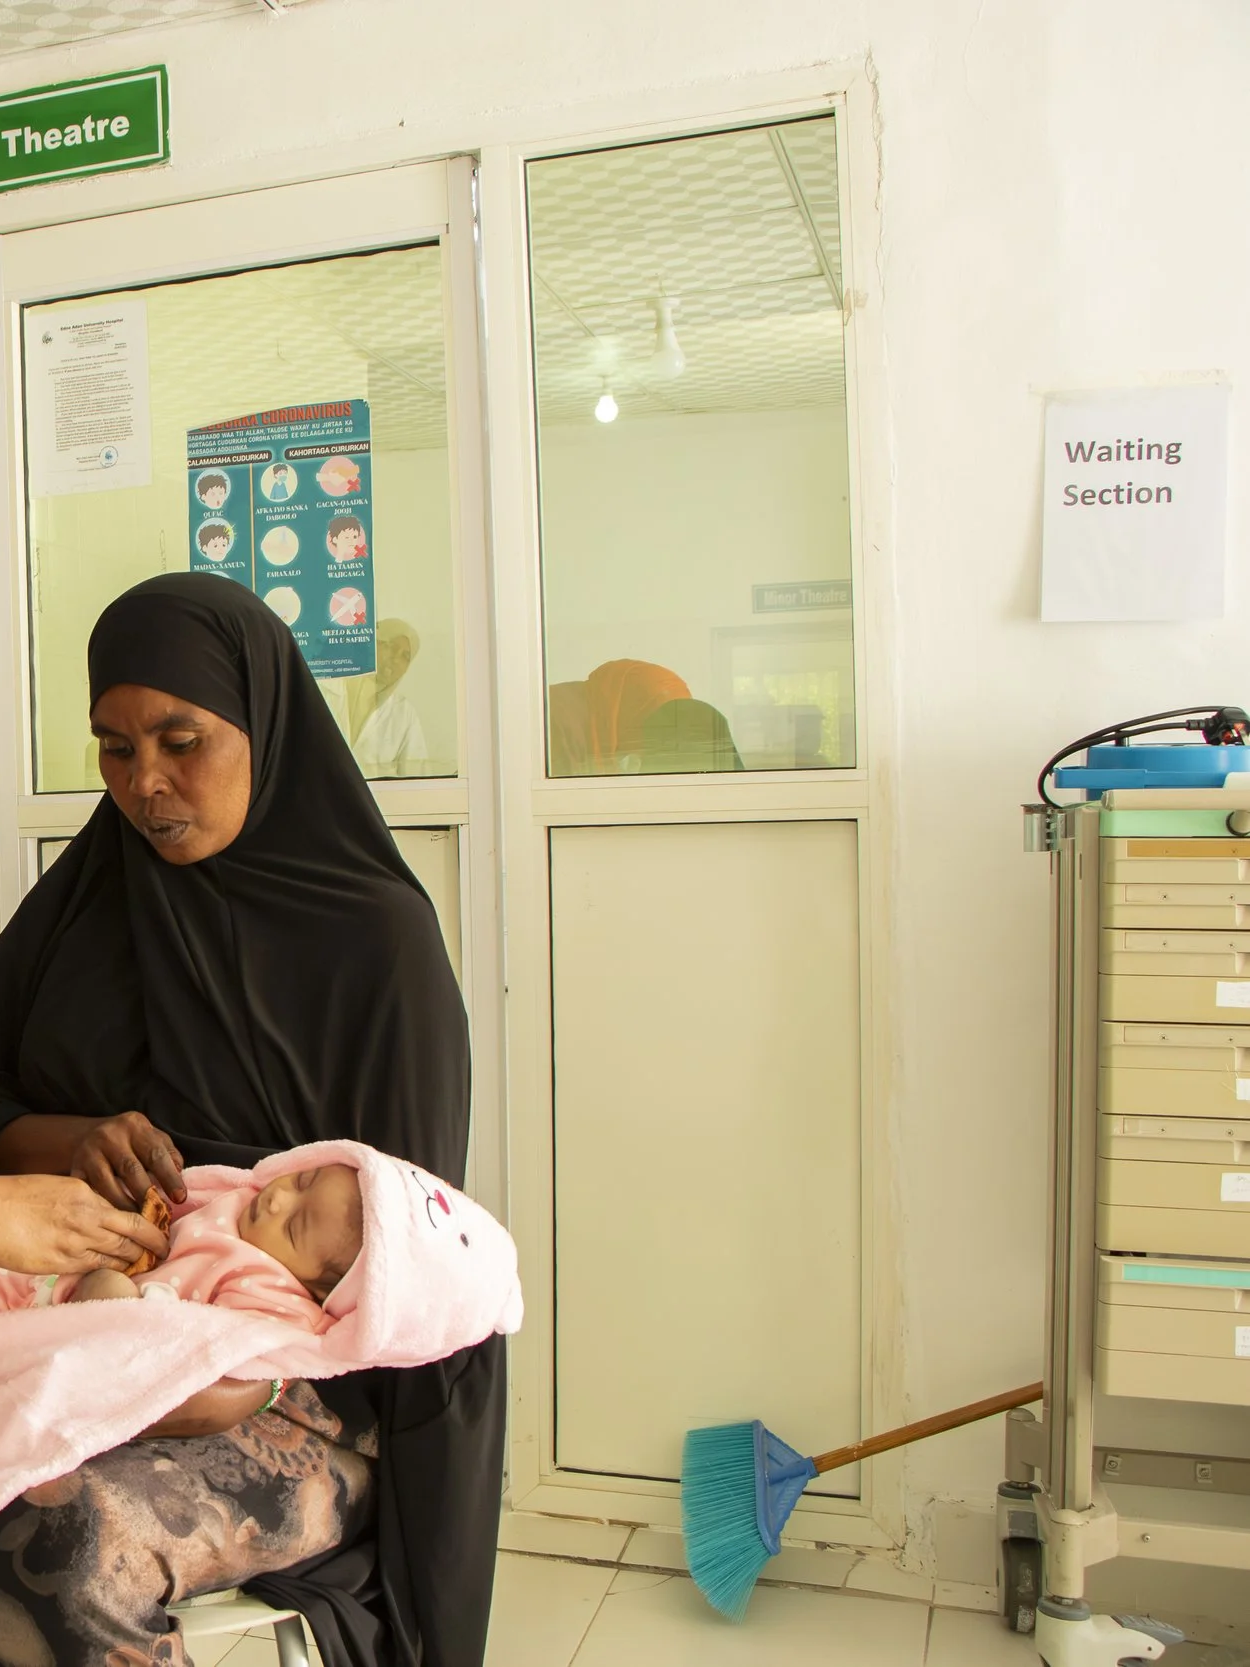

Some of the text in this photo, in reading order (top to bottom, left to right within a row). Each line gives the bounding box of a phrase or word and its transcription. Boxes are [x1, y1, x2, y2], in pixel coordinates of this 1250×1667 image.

[1, 115, 130, 158] Theatre
[261, 401, 352, 425] CORONAVIRUS
[289, 447, 330, 457] KAHORTAGA
[1064, 438, 1182, 465] Waiting
[232, 453, 269, 463] CUDURKAN
[1062, 481, 1173, 507] Section
[286, 504, 308, 512] SANKA
[265, 513, 297, 521] DABOOLO
[266, 569, 301, 578] FARAXALO
[799, 588, 847, 604] Theatre
[321, 627, 374, 637] MEELO KALANA
